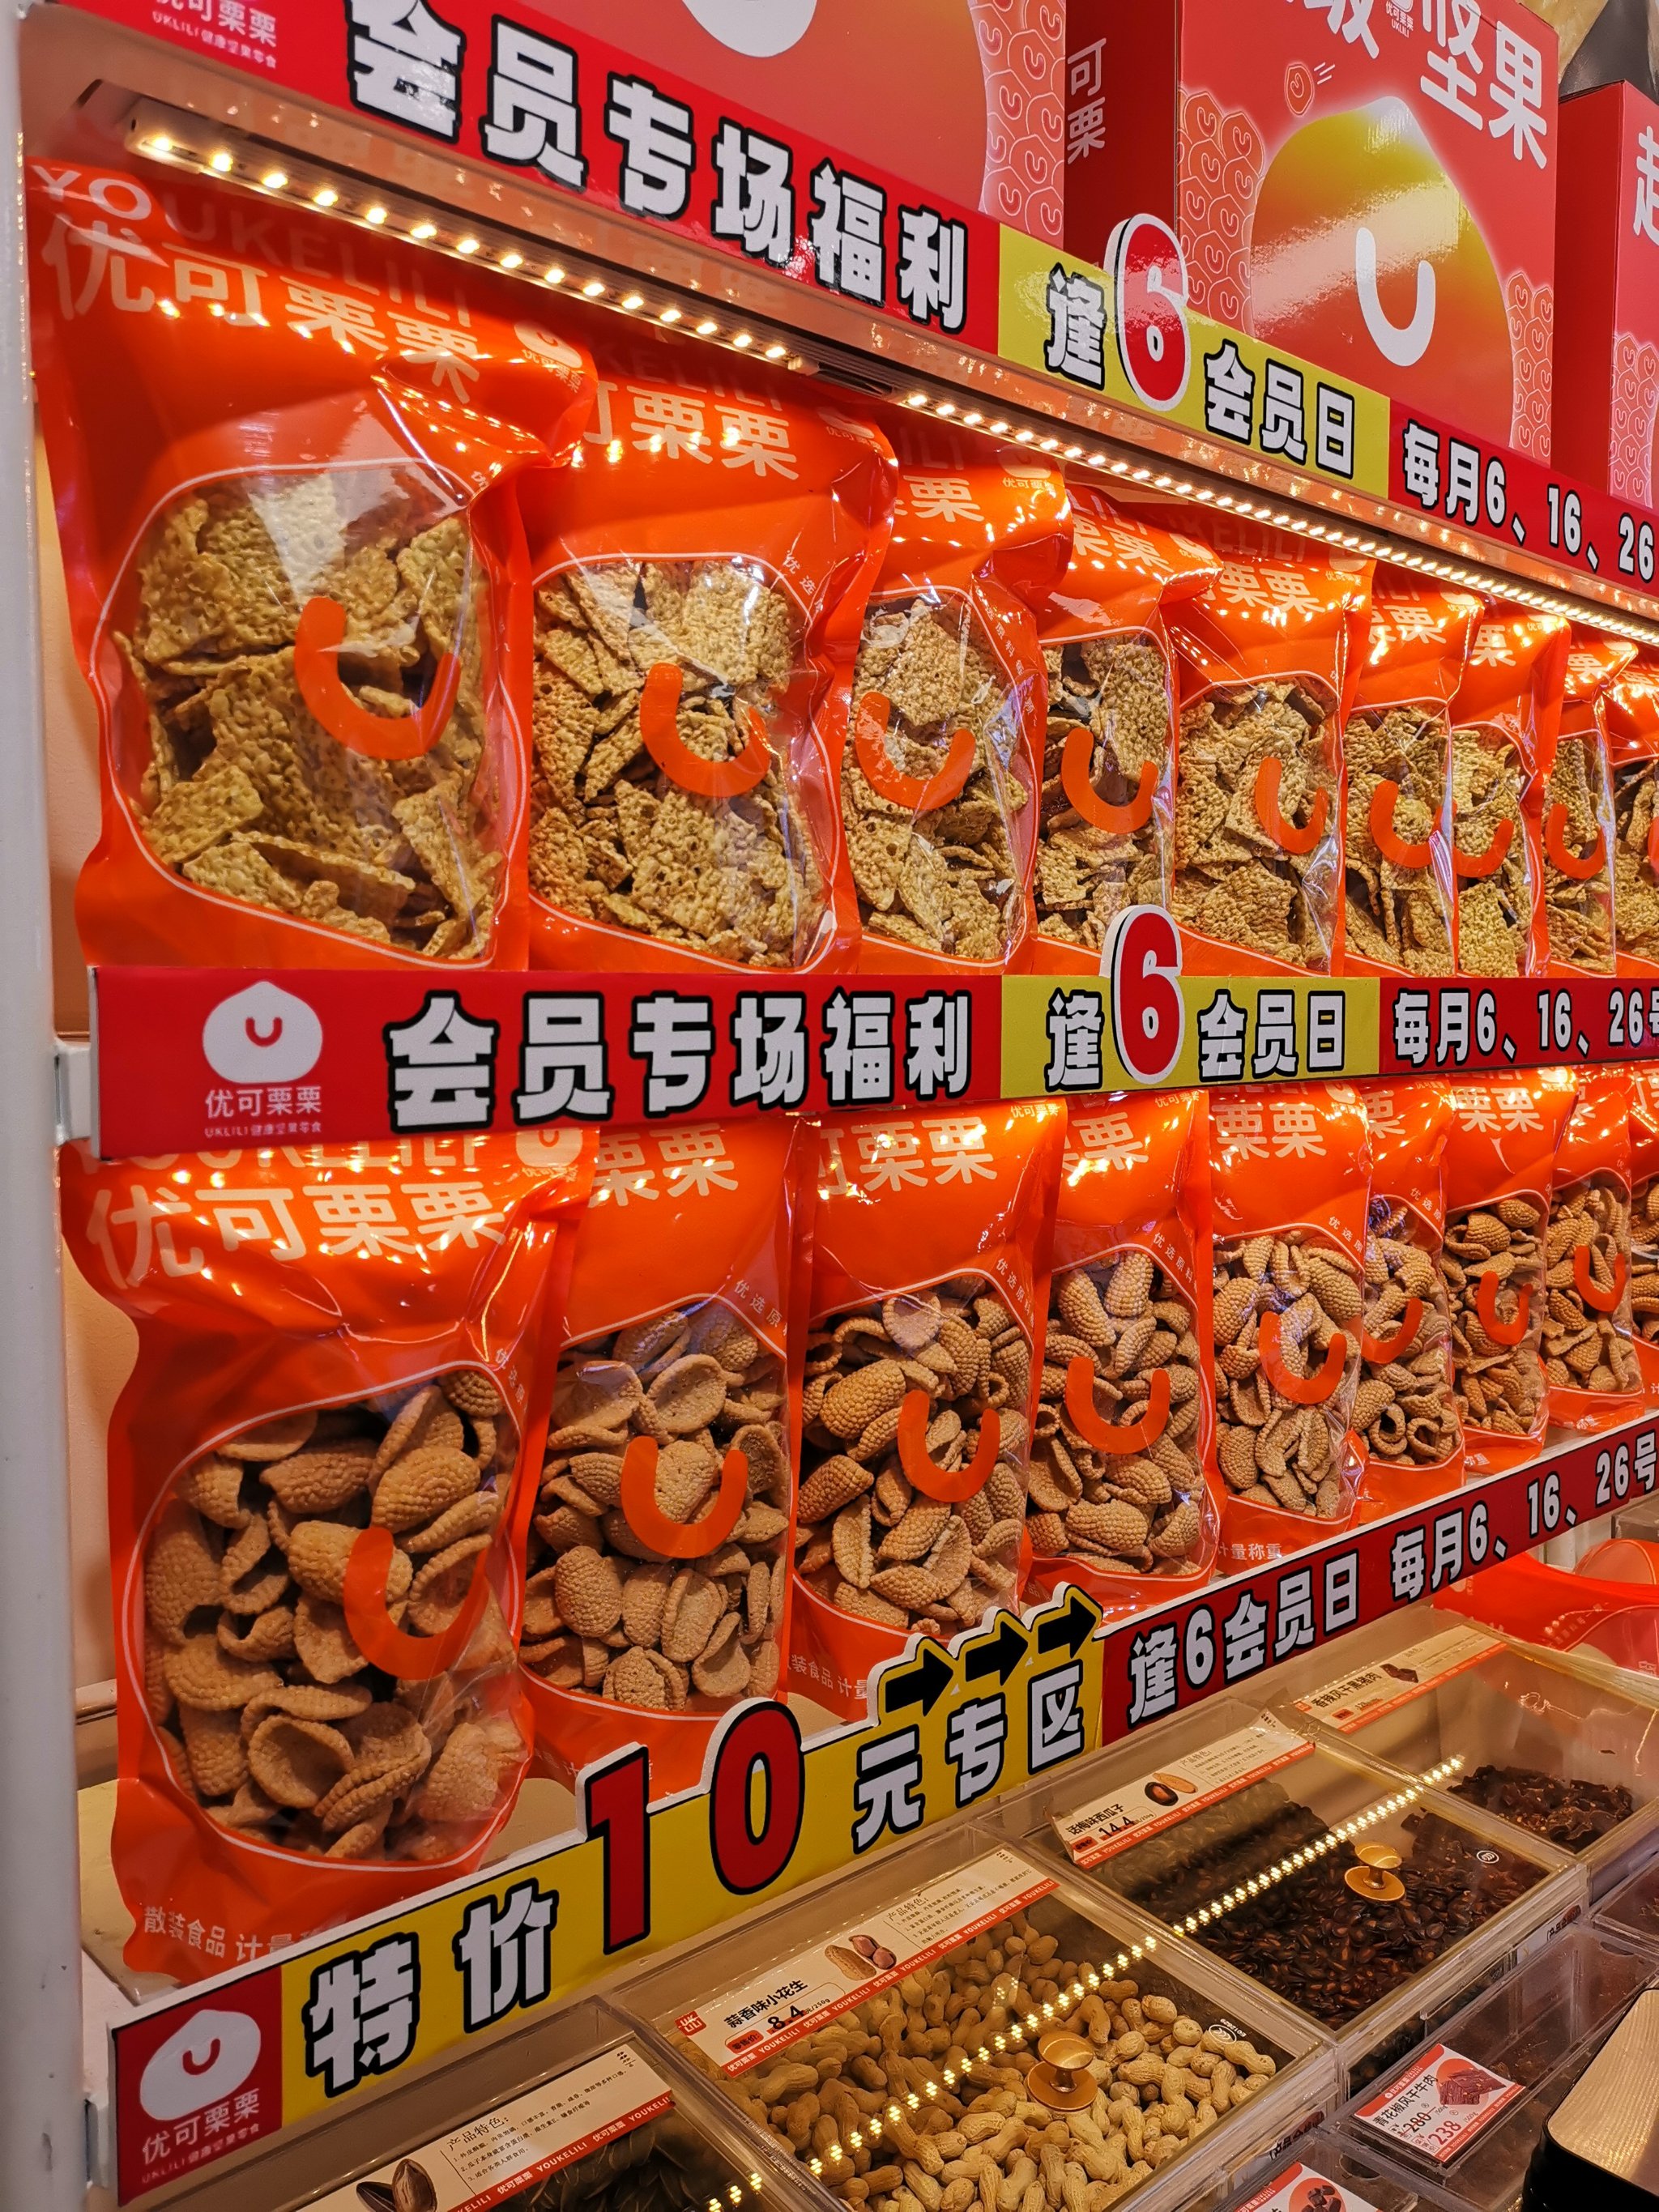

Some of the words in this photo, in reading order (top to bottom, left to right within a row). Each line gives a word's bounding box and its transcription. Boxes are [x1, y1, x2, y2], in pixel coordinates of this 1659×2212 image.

[347, 0, 969, 335] 会员专场福利
[42, 211, 481, 404] 优可栗栗
[893, 474, 986, 523] 栗
[1469, 624, 1517, 668] 栗
[1044, 905, 1346, 1092] 逢6会员日
[383, 988, 972, 1132] 会员专场福利
[205, 1085, 322, 1119] 优可栗栗
[1210, 1102, 1327, 1160] 栗栗
[84, 1180, 507, 1290] 优可栗栗
[1153, 1231, 1197, 1291] 优选原料
[1390, 1429, 1659, 1602] 每月6、16、26号
[1128, 1549, 1359, 1729] 逢6会员日
[787, 1654, 834, 1690] 装食品
[1065, 1803, 1124, 1836] 话梅味西瓜子
[144, 1906, 226, 1958] 散装食品
[723, 1979, 808, 2029] 蒜香味小花生
[758, 2027, 801, 2054] YOUKELILI
[832, 1988, 871, 2012] YOUKELILI
[899, 1950, 937, 1971] YOUKELILI
[963, 1914, 998, 1935] YOUKELILI
[143, 2087, 262, 2167] 优可栗栗
[1372, 2073, 1439, 2127] 青花椒风干牛肉
[535, 2141, 588, 2173] YOUKELILI
[1428, 2120, 1463, 2146] 238
